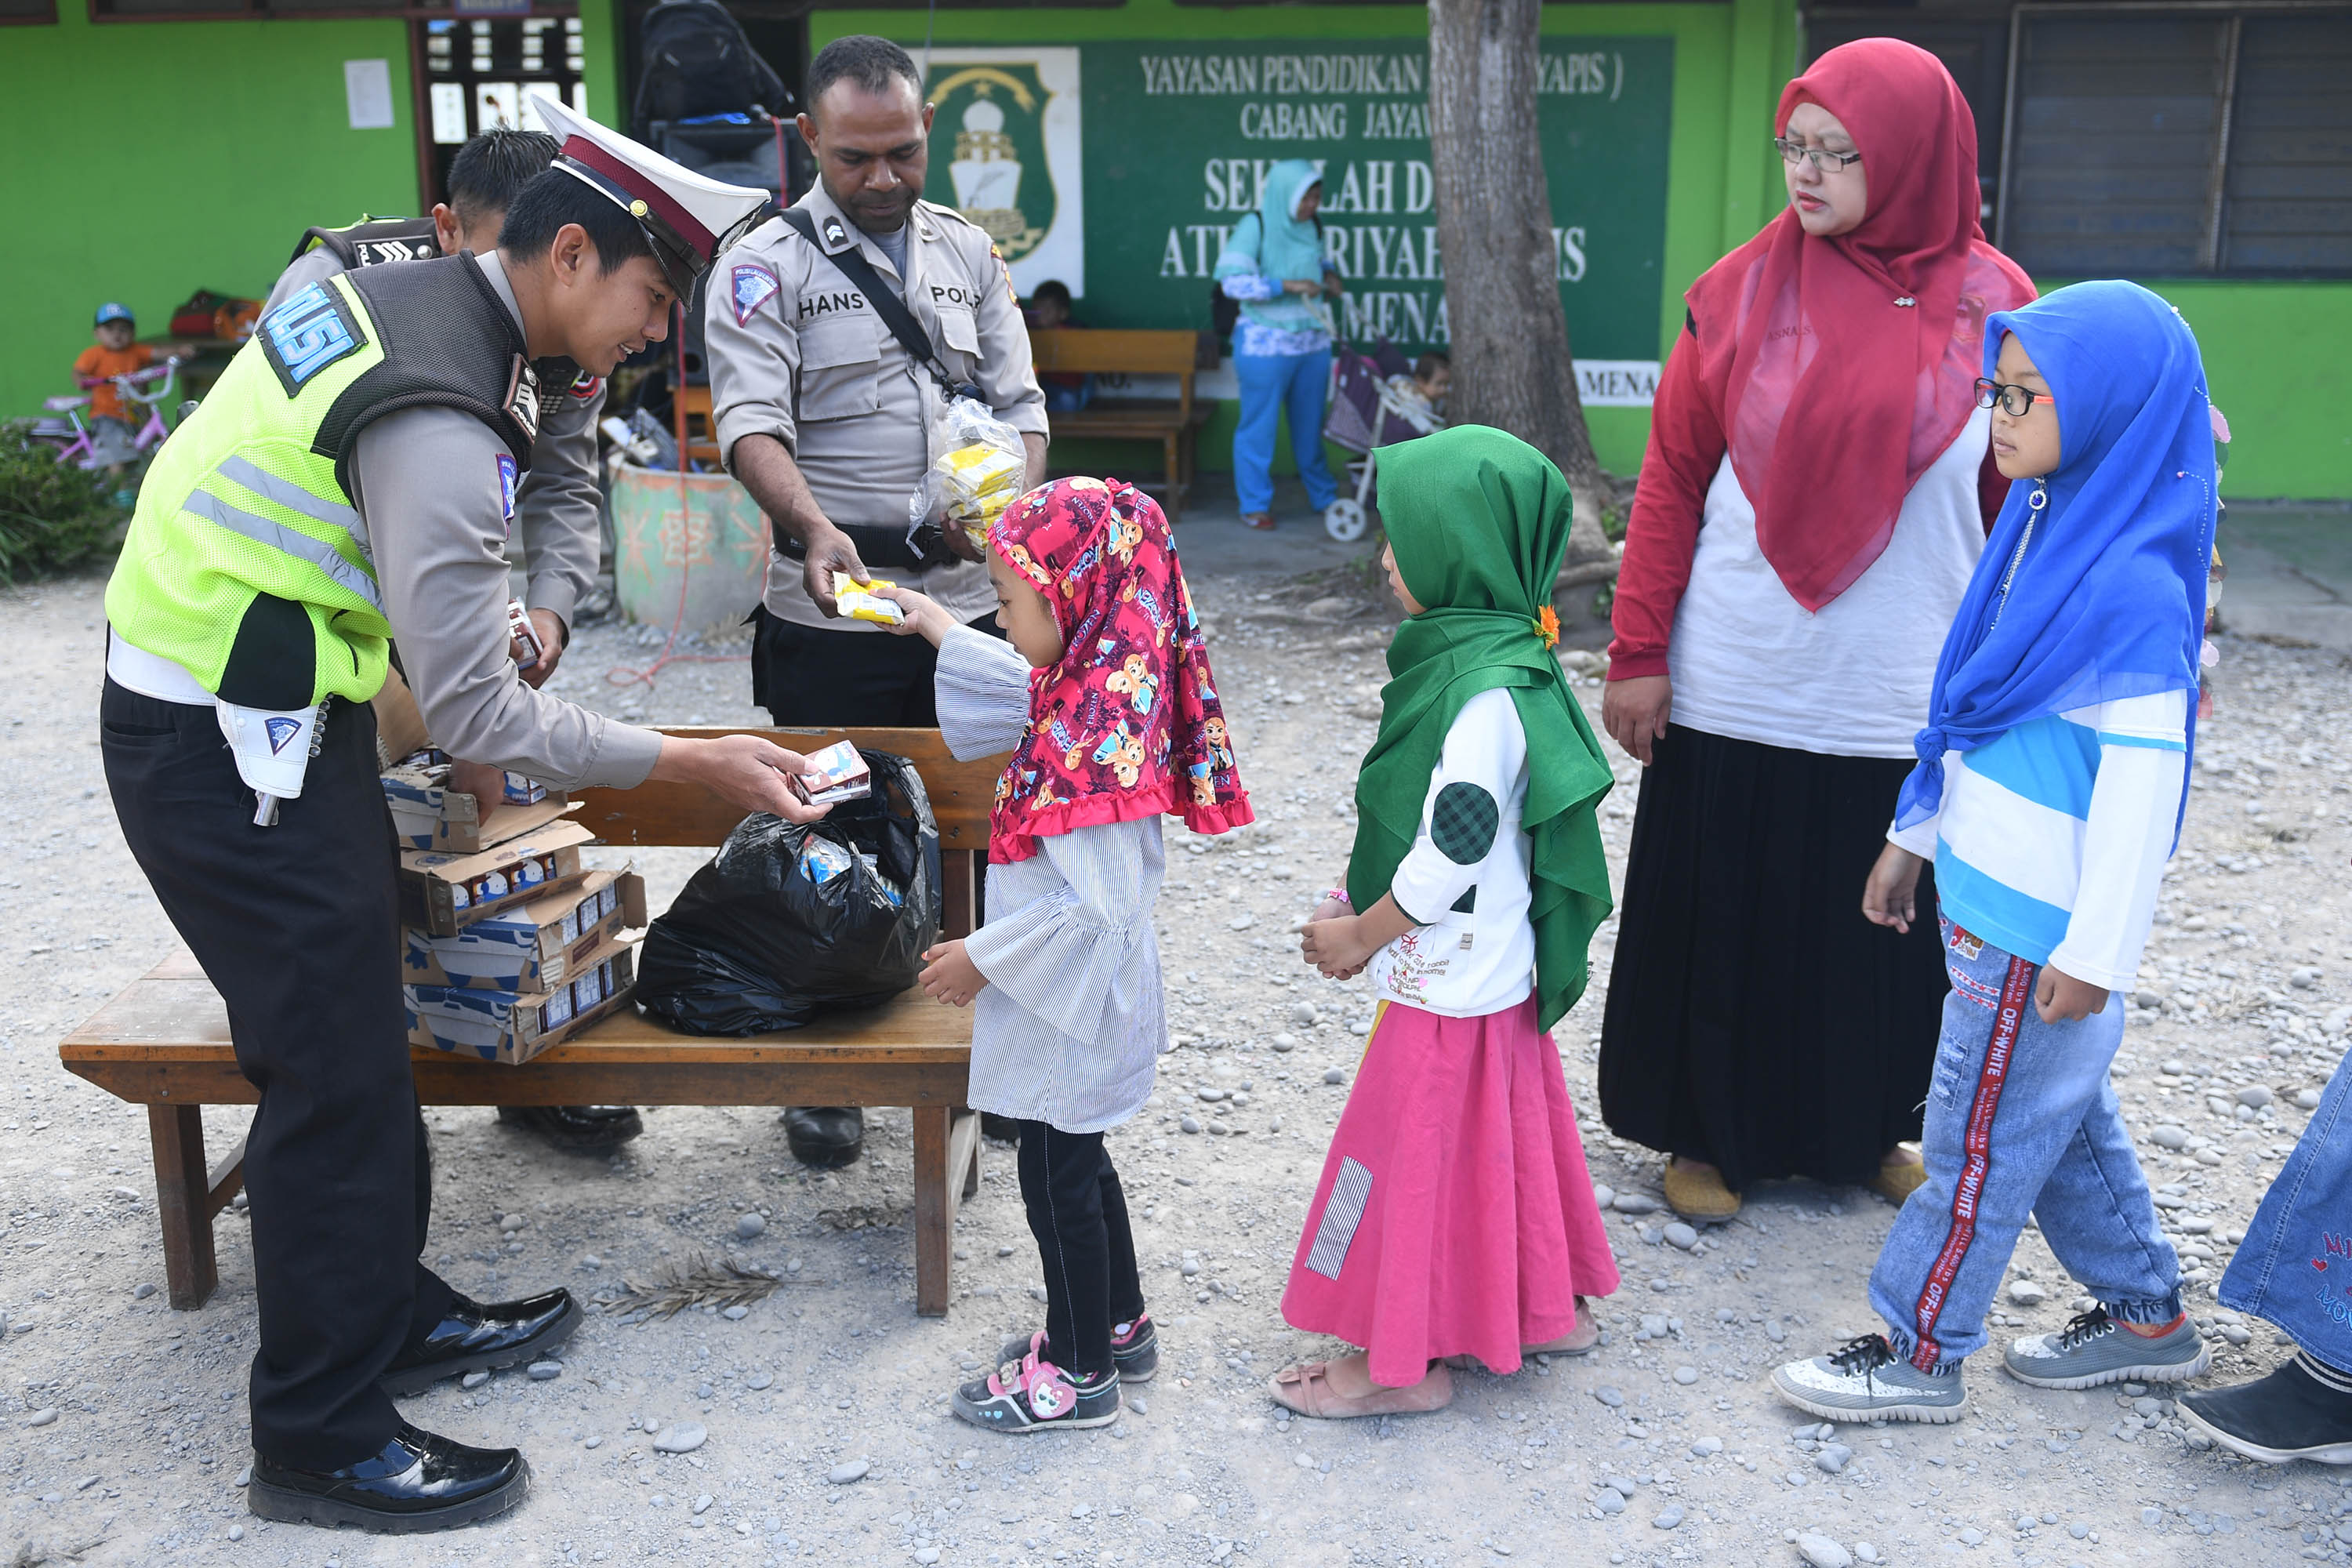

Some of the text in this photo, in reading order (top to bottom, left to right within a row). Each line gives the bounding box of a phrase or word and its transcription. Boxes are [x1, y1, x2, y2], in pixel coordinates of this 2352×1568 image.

[1141, 55, 1256, 94] YAYASAN
[1262, 54, 1423, 93] PENDIDIKAN
[1240, 102, 1348, 140] CABANG
[799, 292, 864, 320] HANS
[1134, 586, 1163, 630] FROZEN
[1087, 692, 1098, 724] FROZEN
[1987, 1007, 2017, 1077] OFF-WHITE
[1957, 1153, 1985, 1219] OFF-WHITE
